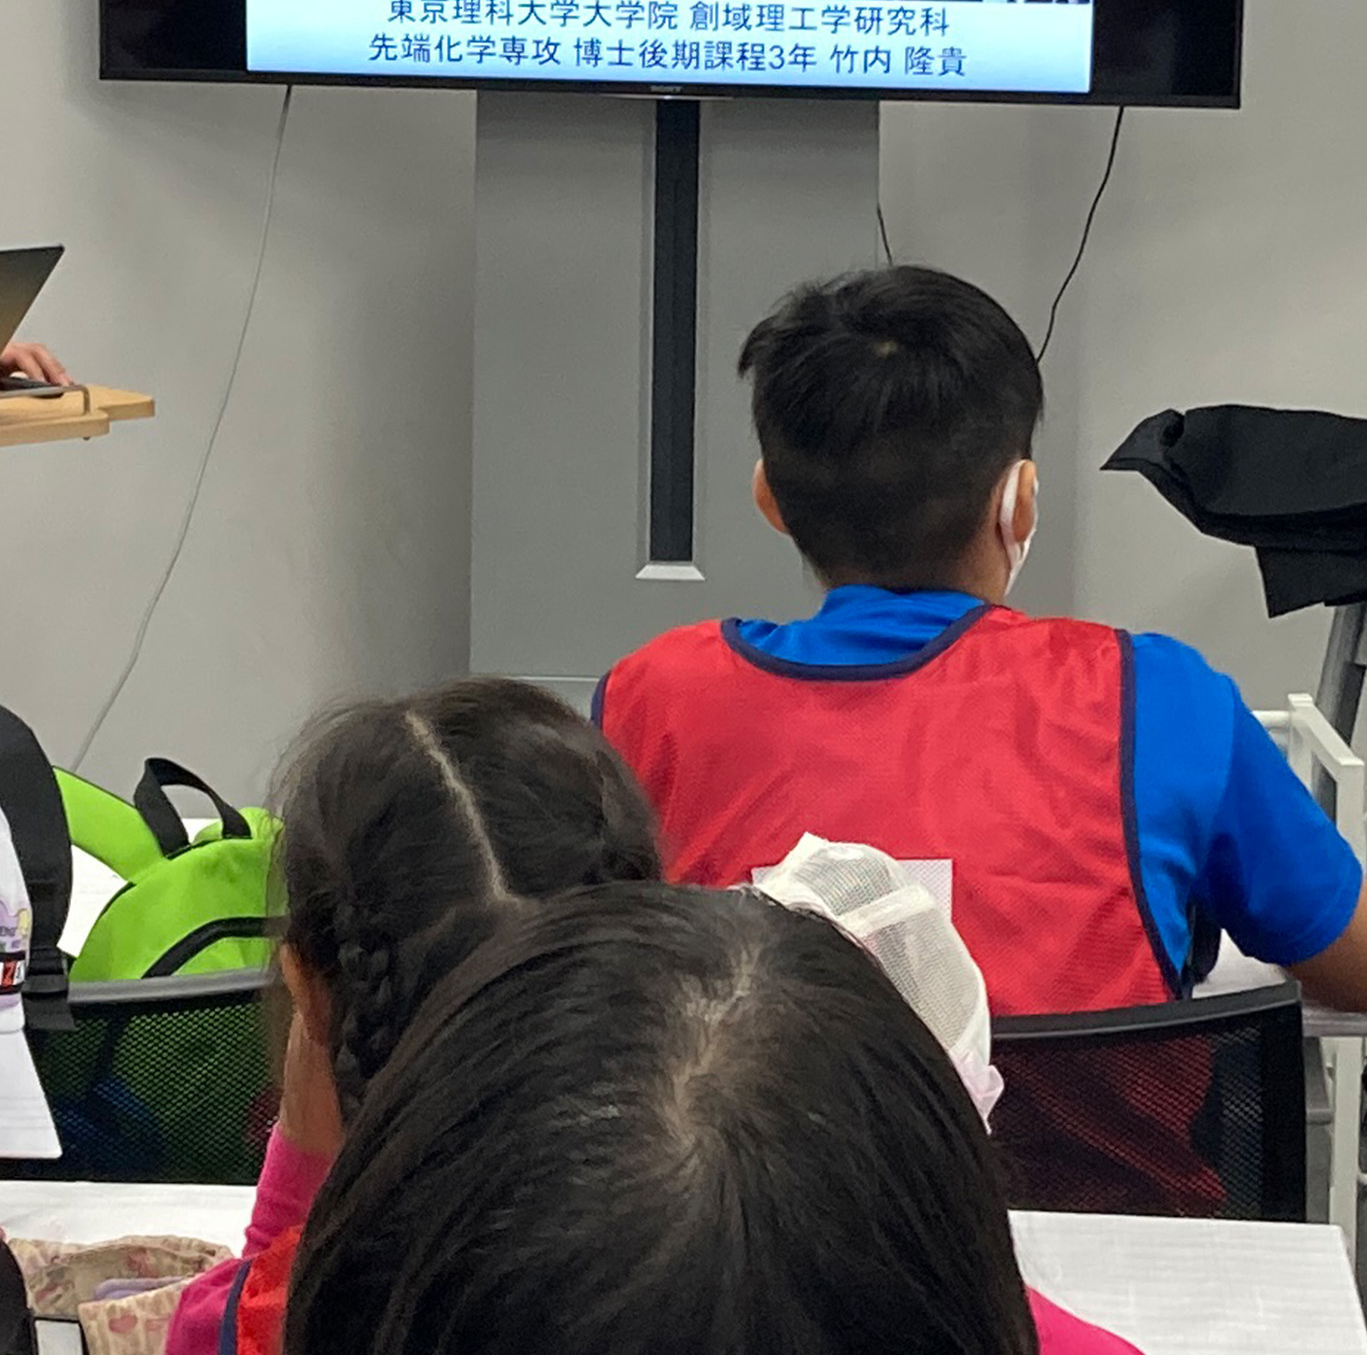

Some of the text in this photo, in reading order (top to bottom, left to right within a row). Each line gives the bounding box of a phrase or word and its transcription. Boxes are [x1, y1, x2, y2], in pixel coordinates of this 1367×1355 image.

[689, 0, 950, 37] 創域理工学研究科
[368, 32, 968, 77] 先端化学専攻 博士後期課程3年 竹内 隆貴
